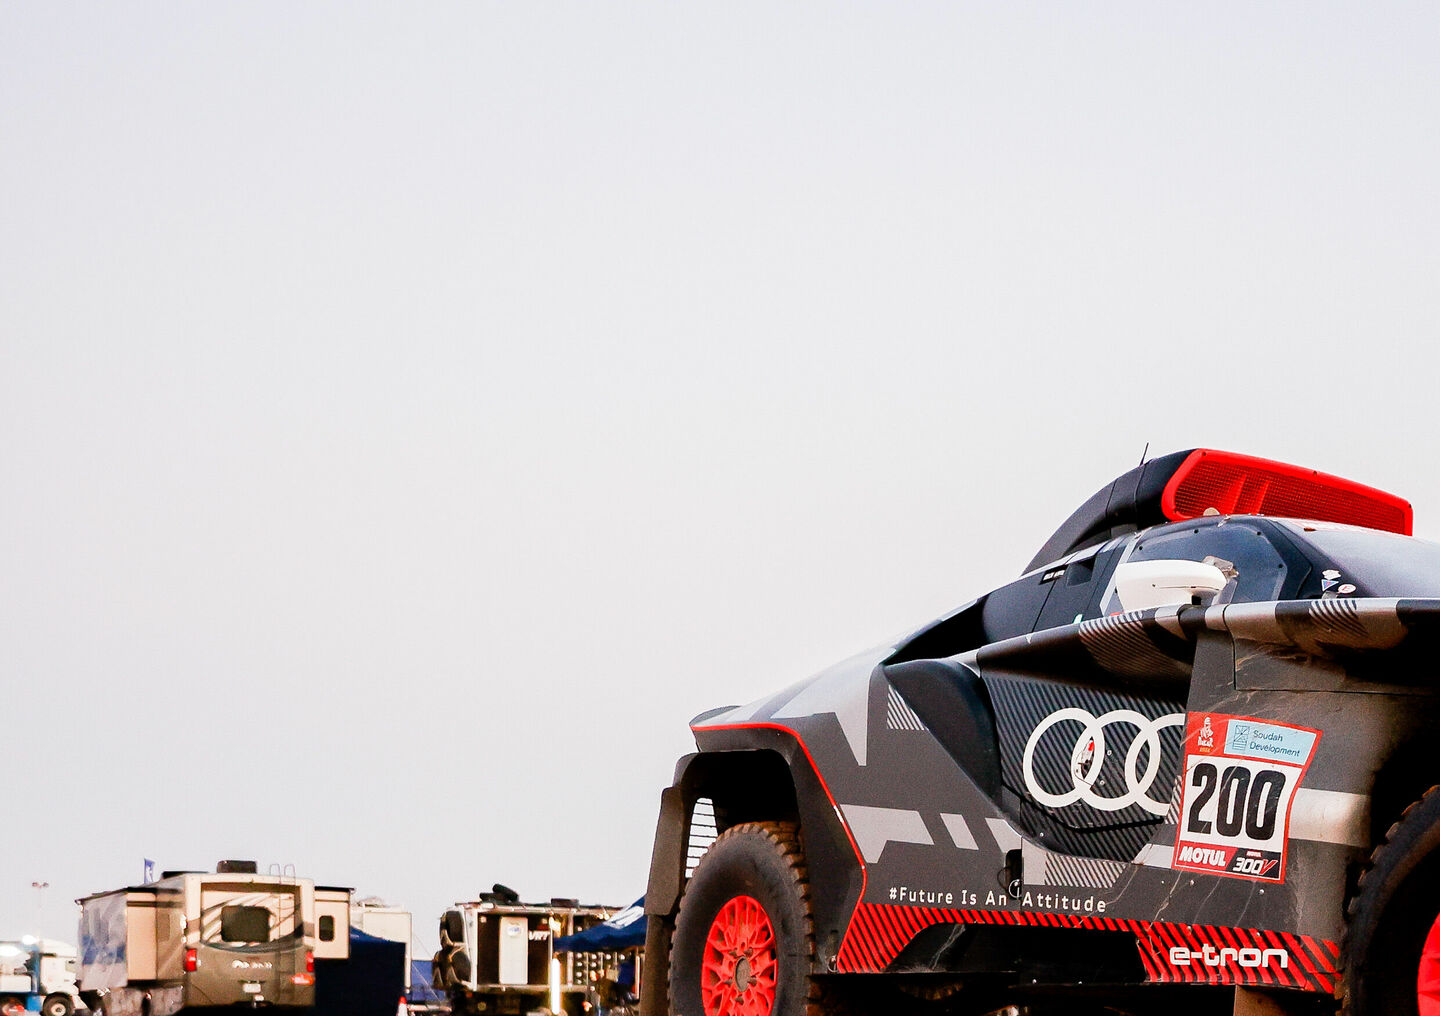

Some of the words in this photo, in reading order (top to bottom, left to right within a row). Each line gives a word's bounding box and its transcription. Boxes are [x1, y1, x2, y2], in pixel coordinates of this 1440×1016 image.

[1253, 729, 1283, 742] Soudah
[1249, 741, 1301, 757] Development
[1187, 762, 1287, 841] 200
[1179, 845, 1227, 867] MOTUL
[1232, 857, 1279, 876] 300V
[889, 886, 953, 905] #Future
[961, 889, 978, 906] Is
[985, 890, 1007, 906] An
[1022, 891, 1107, 913] Attitude
[1169, 942, 1289, 969] e-tron
